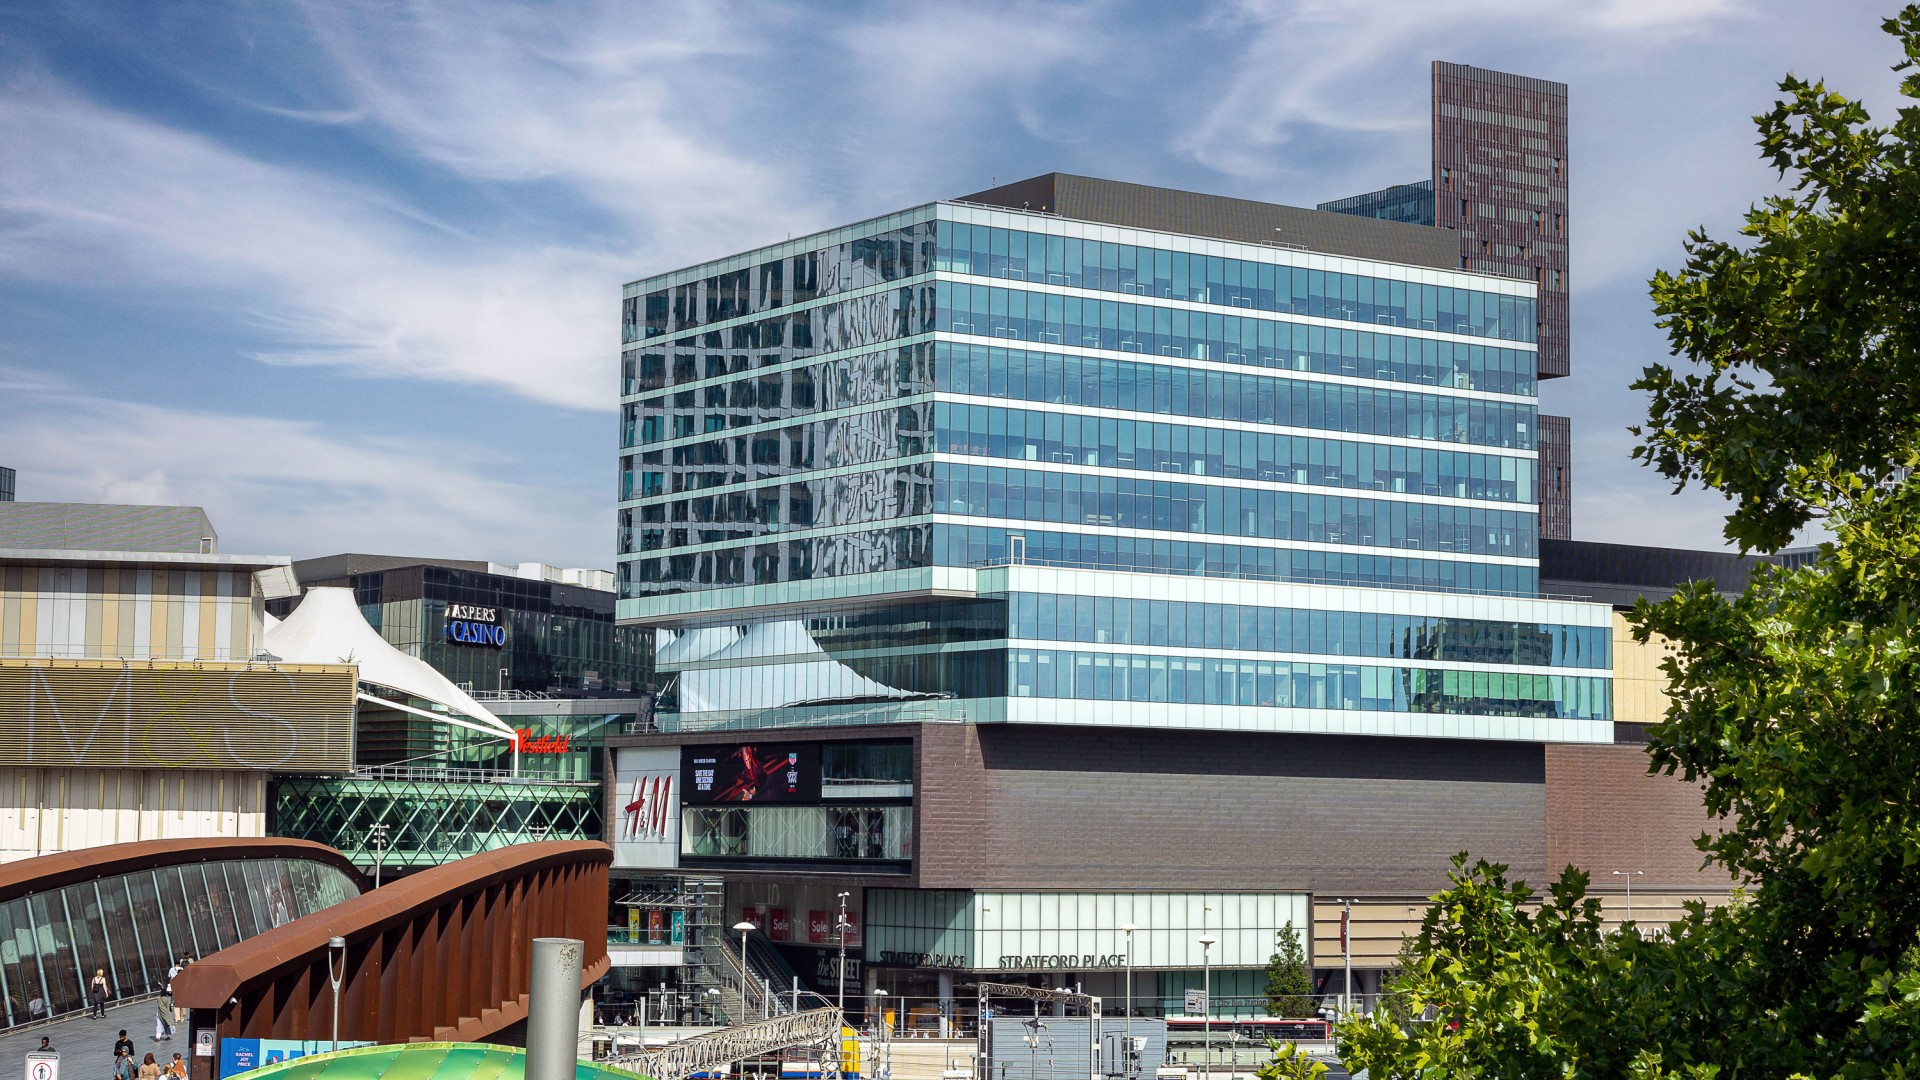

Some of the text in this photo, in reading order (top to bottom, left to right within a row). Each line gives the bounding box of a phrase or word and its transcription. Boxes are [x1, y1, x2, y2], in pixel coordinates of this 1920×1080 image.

[452, 605, 496, 622] ASPERS
[450, 621, 506, 646] CASINO
[26, 663, 298, 769] M&S
[509, 728, 571, 753] Westfield
[623, 775, 672, 840] H&M
[773, 918, 789, 930] Sale
[811, 920, 828, 932] Sale
[817, 958, 829, 976] the
[936, 953, 966, 969] PLACE
[998, 954, 1126, 970] STRATFORD PLACE
[1217, 999, 1231, 1008] City
[1232, 999, 1243, 1007] Bus
[1244, 999, 1267, 1007] Station
